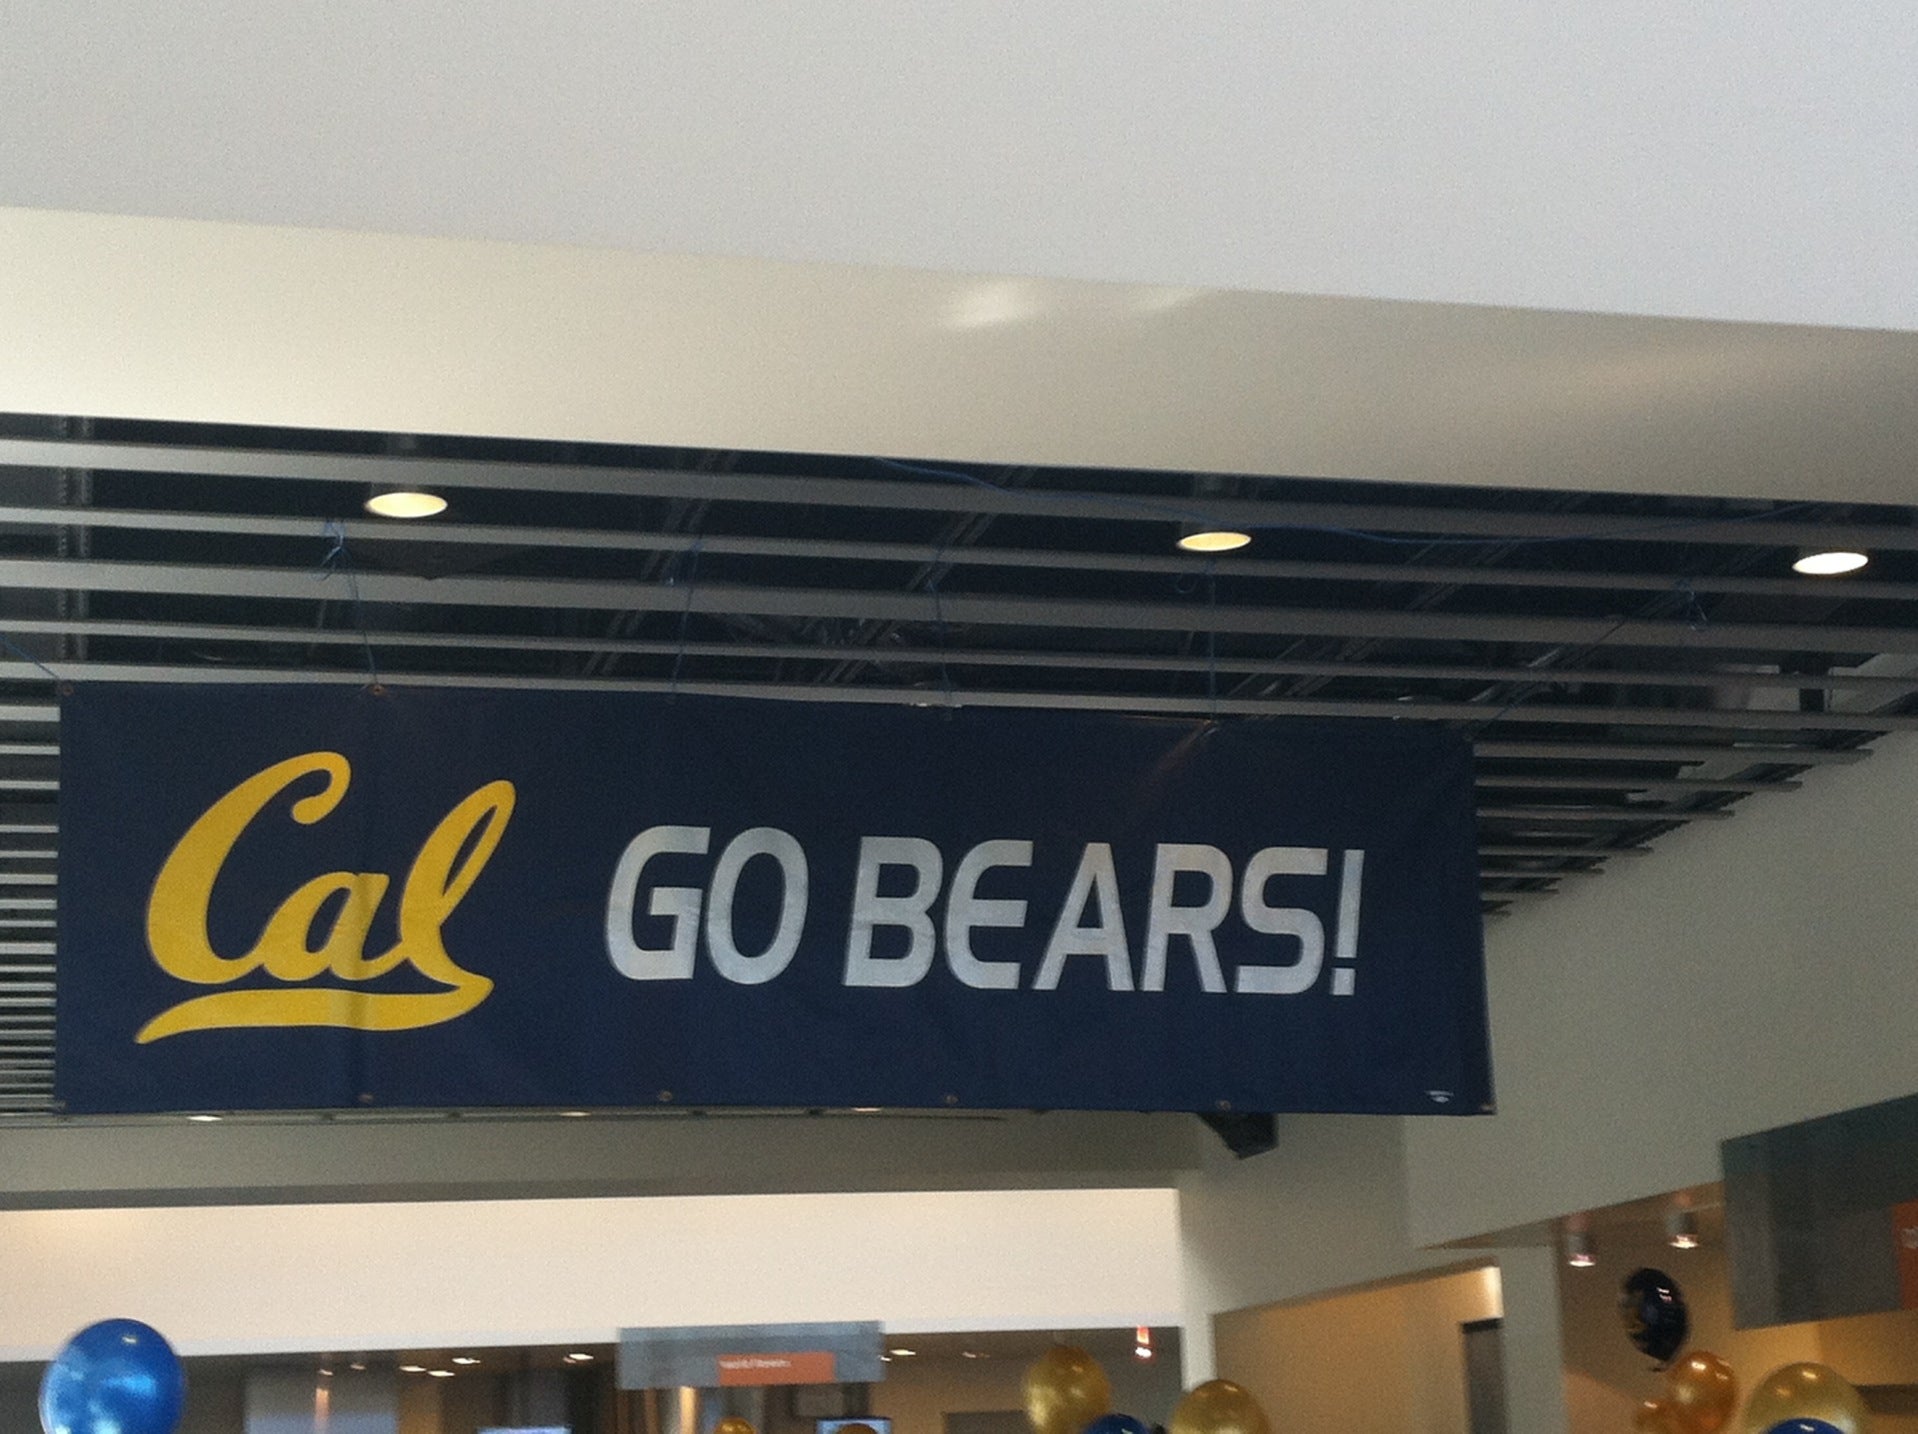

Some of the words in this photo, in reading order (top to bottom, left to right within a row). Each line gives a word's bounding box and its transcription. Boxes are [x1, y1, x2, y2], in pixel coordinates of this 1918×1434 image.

[135, 751, 516, 1044] Cal
[606, 825, 808, 985] GO
[844, 837, 1364, 996] BEARS!
